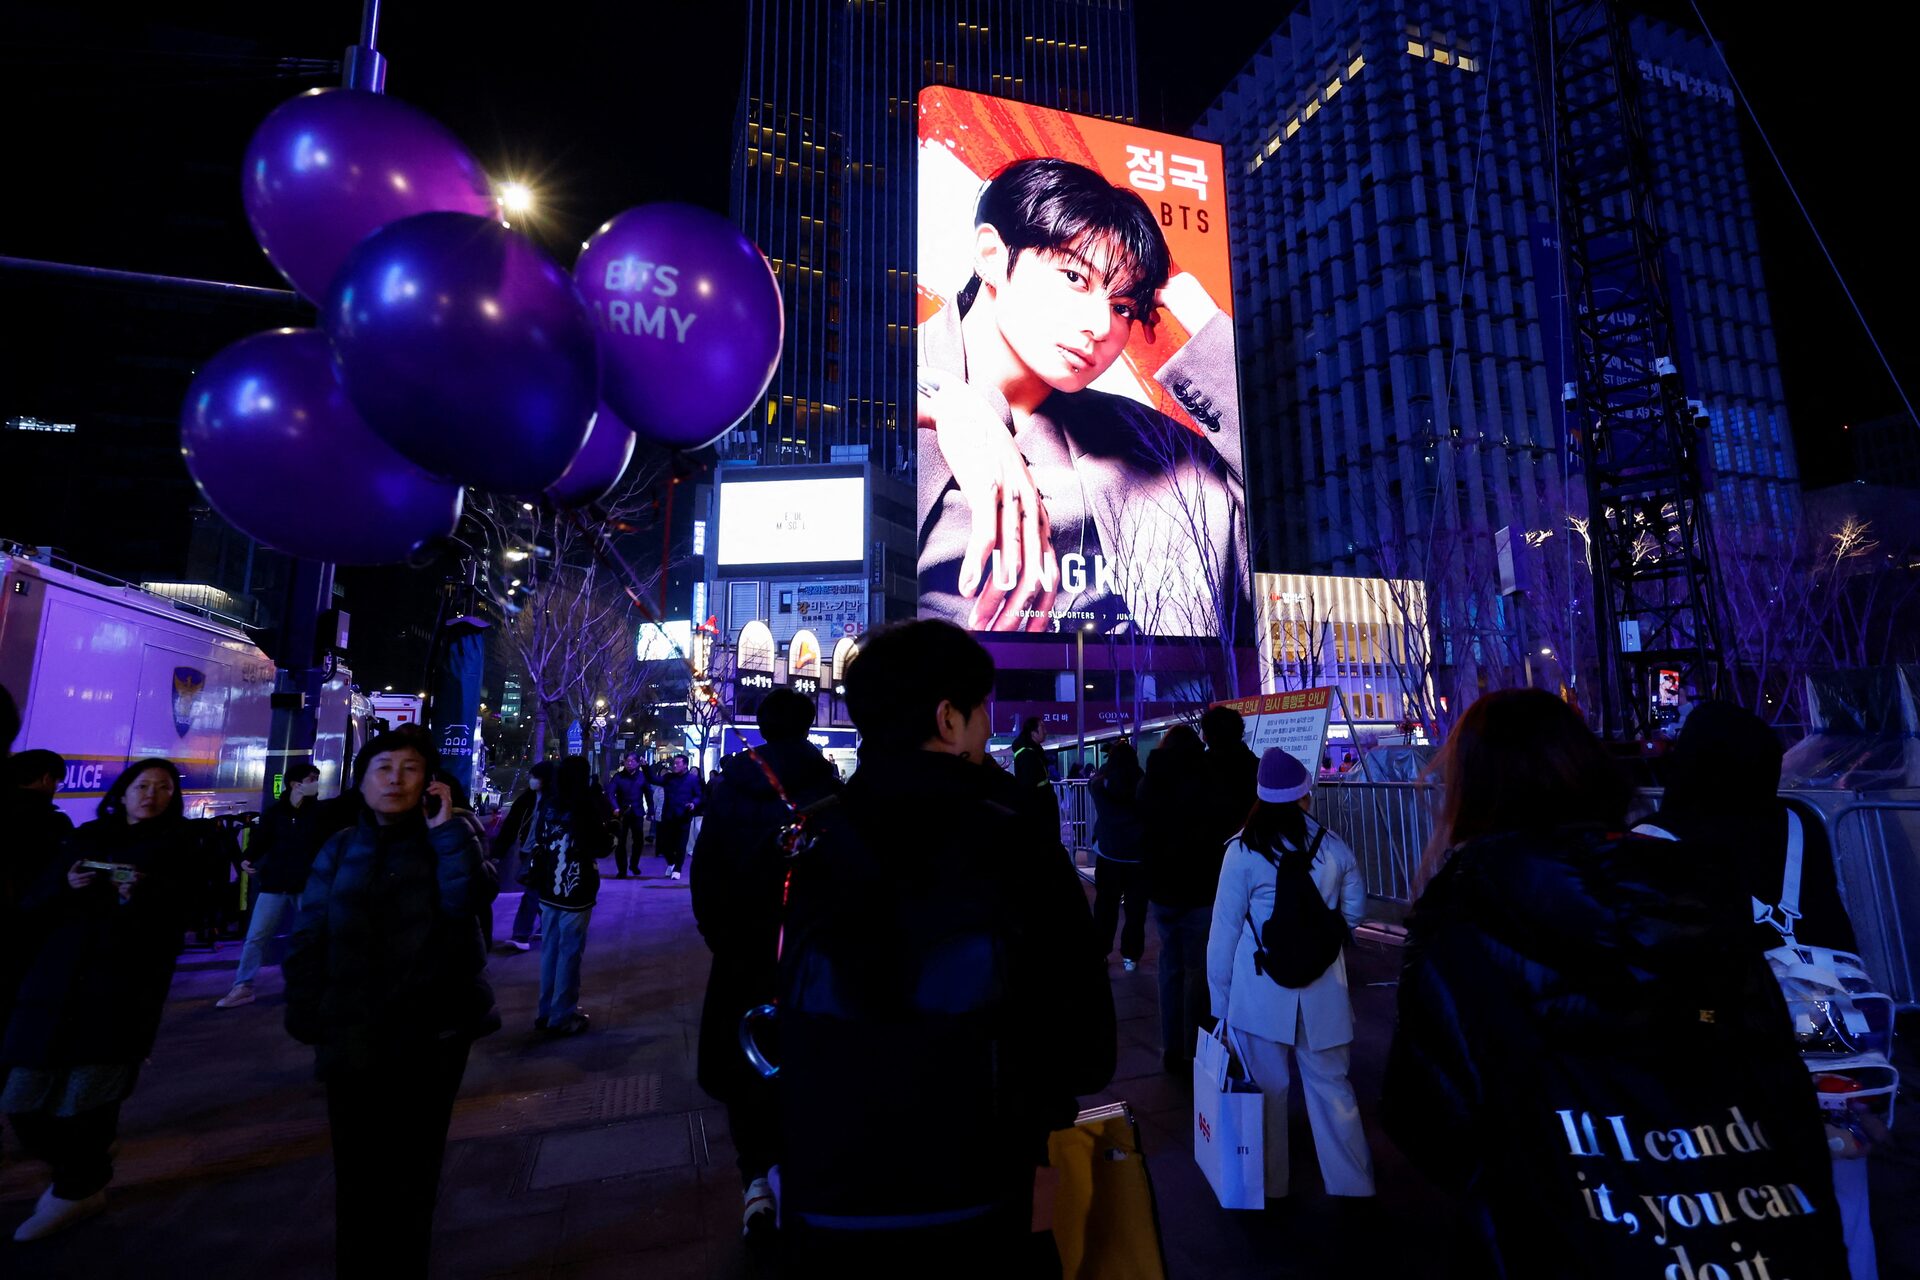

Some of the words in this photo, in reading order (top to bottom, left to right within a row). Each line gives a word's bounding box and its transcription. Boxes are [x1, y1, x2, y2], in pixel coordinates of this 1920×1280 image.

[1126, 144, 1208, 201] 정국
[1160, 201, 1209, 233] BTS
[605, 260, 679, 298] BTS
[1048, 610, 1095, 620] SUPPORTERS
[1245, 699, 1259, 714] 안내
[1264, 698, 1281, 711] 임시
[1282, 694, 1306, 710] 통행로
[1307, 690, 1326, 707] 안내
[1043, 713, 1069, 722] 고디바
[1098, 711, 1130, 720] GODVA
[63, 764, 104, 789] OLICE
[1555, 1109, 1605, 1156] If
[1605, 1115, 1640, 1163] I
[1644, 1124, 1727, 1162] can
[1576, 1170, 1640, 1234] it,
[1638, 1192, 1738, 1246] you
[1737, 1183, 1818, 1221] can
[1664, 1244, 1733, 1280] do
